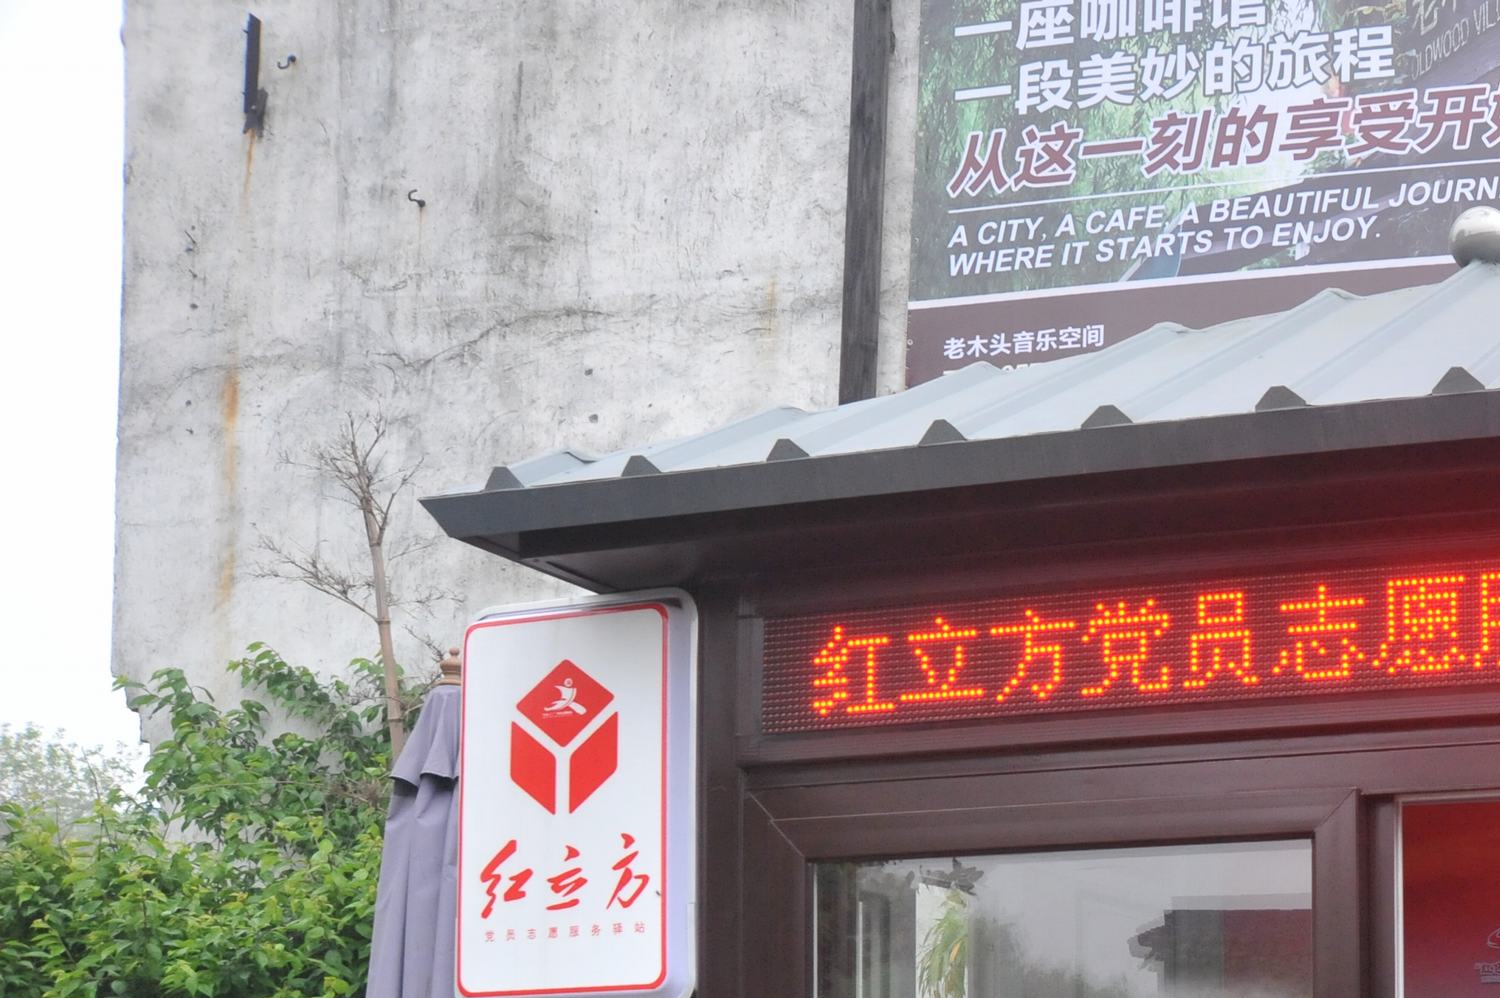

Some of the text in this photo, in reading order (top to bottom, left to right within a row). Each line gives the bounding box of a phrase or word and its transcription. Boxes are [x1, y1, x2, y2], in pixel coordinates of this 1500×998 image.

[954, 25, 1395, 115] 一段美妙的旅程
[947, 225, 968, 248] A
[977, 216, 1047, 245] CITY,
[1054, 214, 1076, 237] A
[1172, 200, 1200, 226] A
[1209, 187, 1379, 223] BEAUTIFUL
[949, 215, 1381, 276] WHERE IT STARTS TO ENJOY.
[943, 324, 1105, 360] 老木头音乐空间
[480, 832, 651, 920] 红立方
